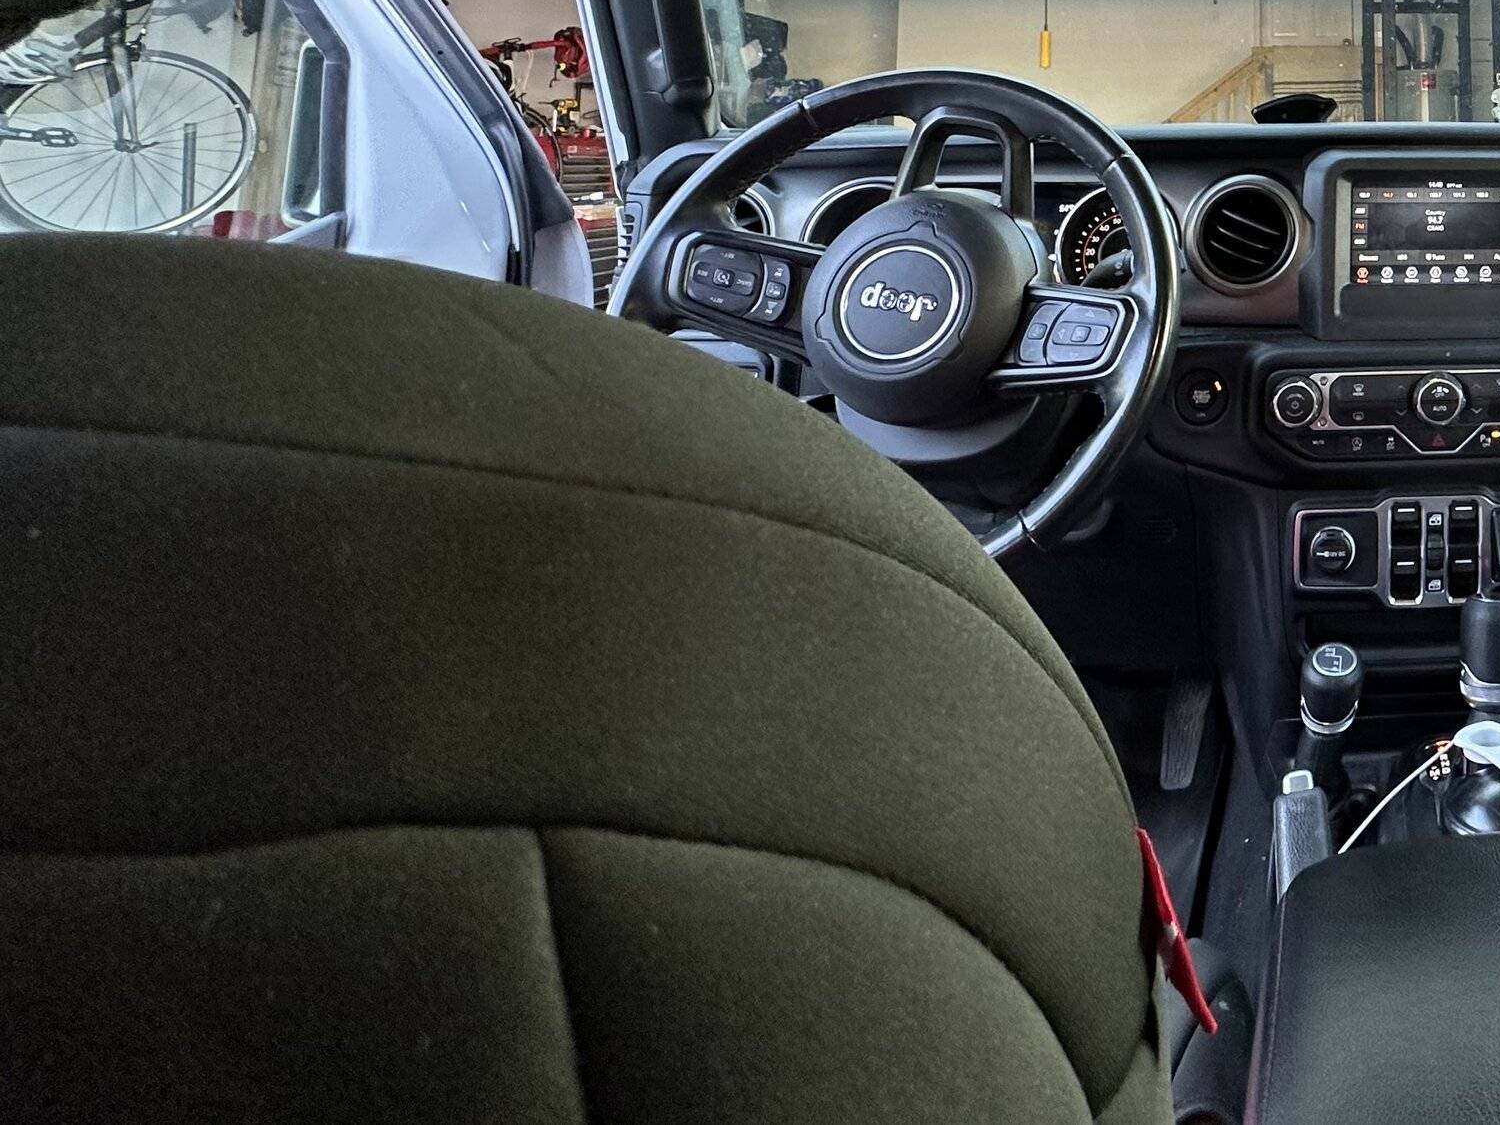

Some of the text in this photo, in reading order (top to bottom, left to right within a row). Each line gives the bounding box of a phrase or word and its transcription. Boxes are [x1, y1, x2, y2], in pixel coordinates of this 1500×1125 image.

[1099, 224, 1110, 232] 40
[1085, 248, 1096, 256] 20
[860, 281, 939, 322] Jeep
